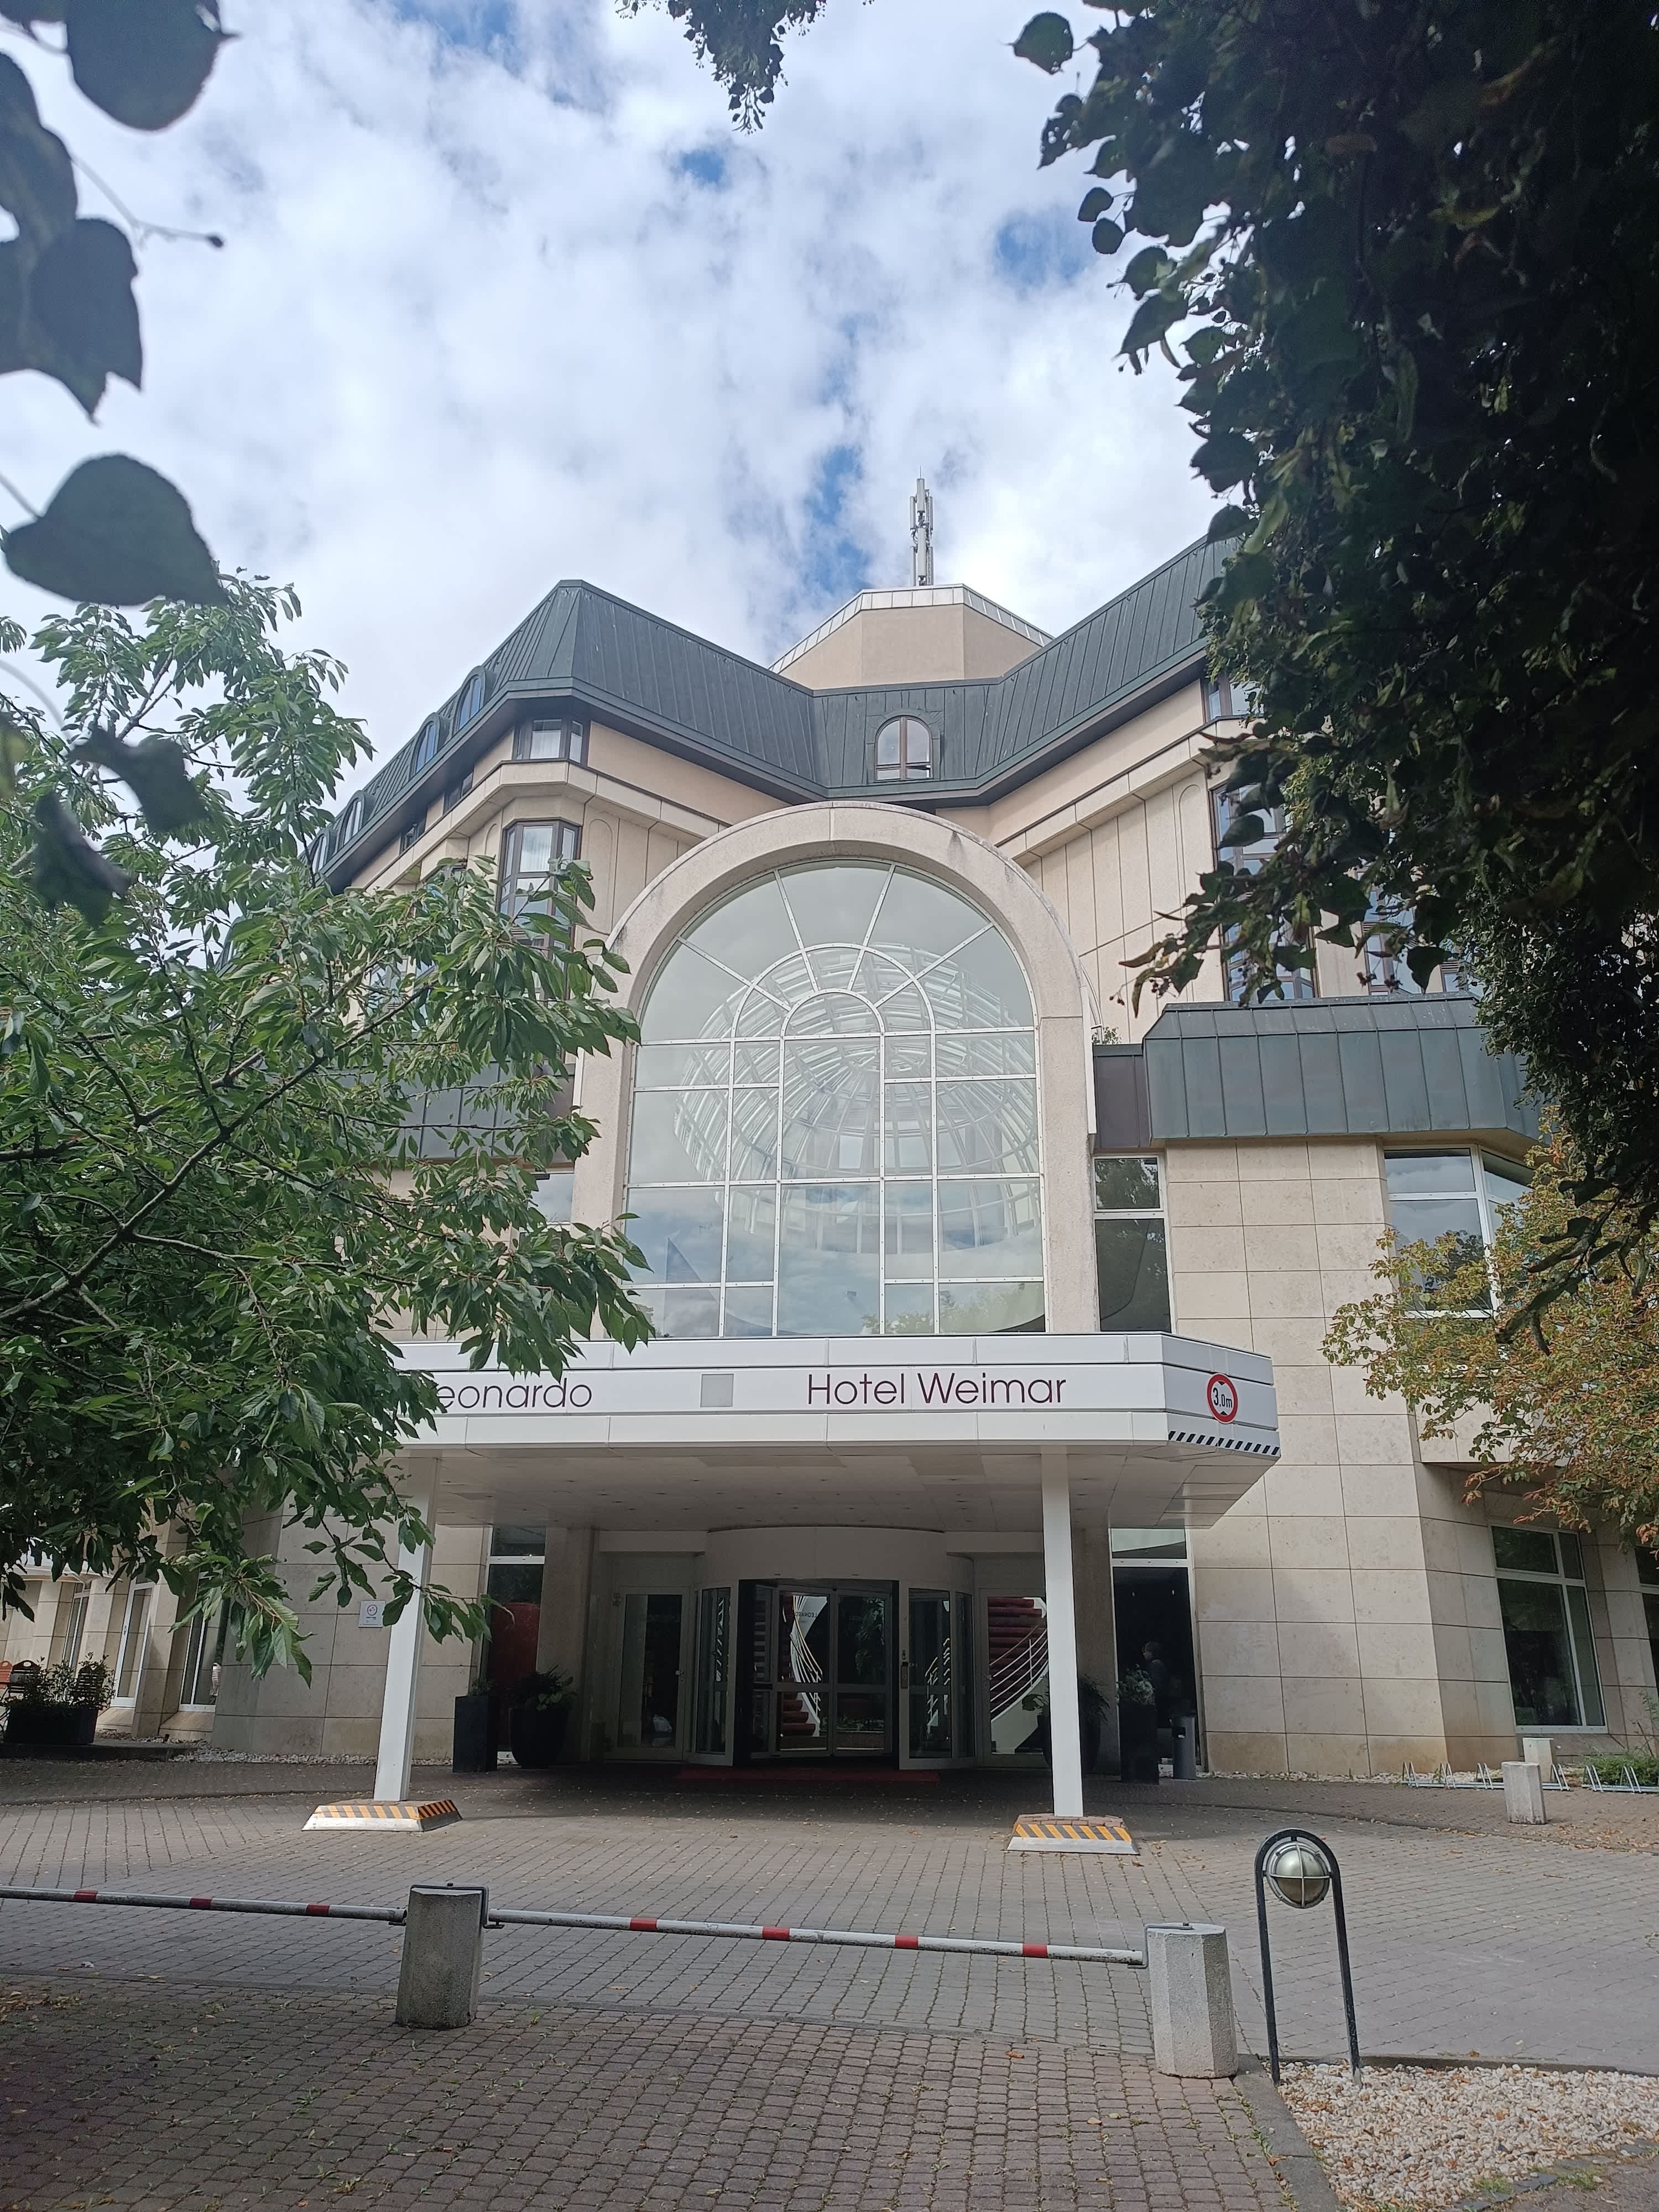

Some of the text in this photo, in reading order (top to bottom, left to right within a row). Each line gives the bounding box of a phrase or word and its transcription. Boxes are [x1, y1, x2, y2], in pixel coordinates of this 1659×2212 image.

[436, 1373, 1066, 1408] eonardo Hotel Weimar
